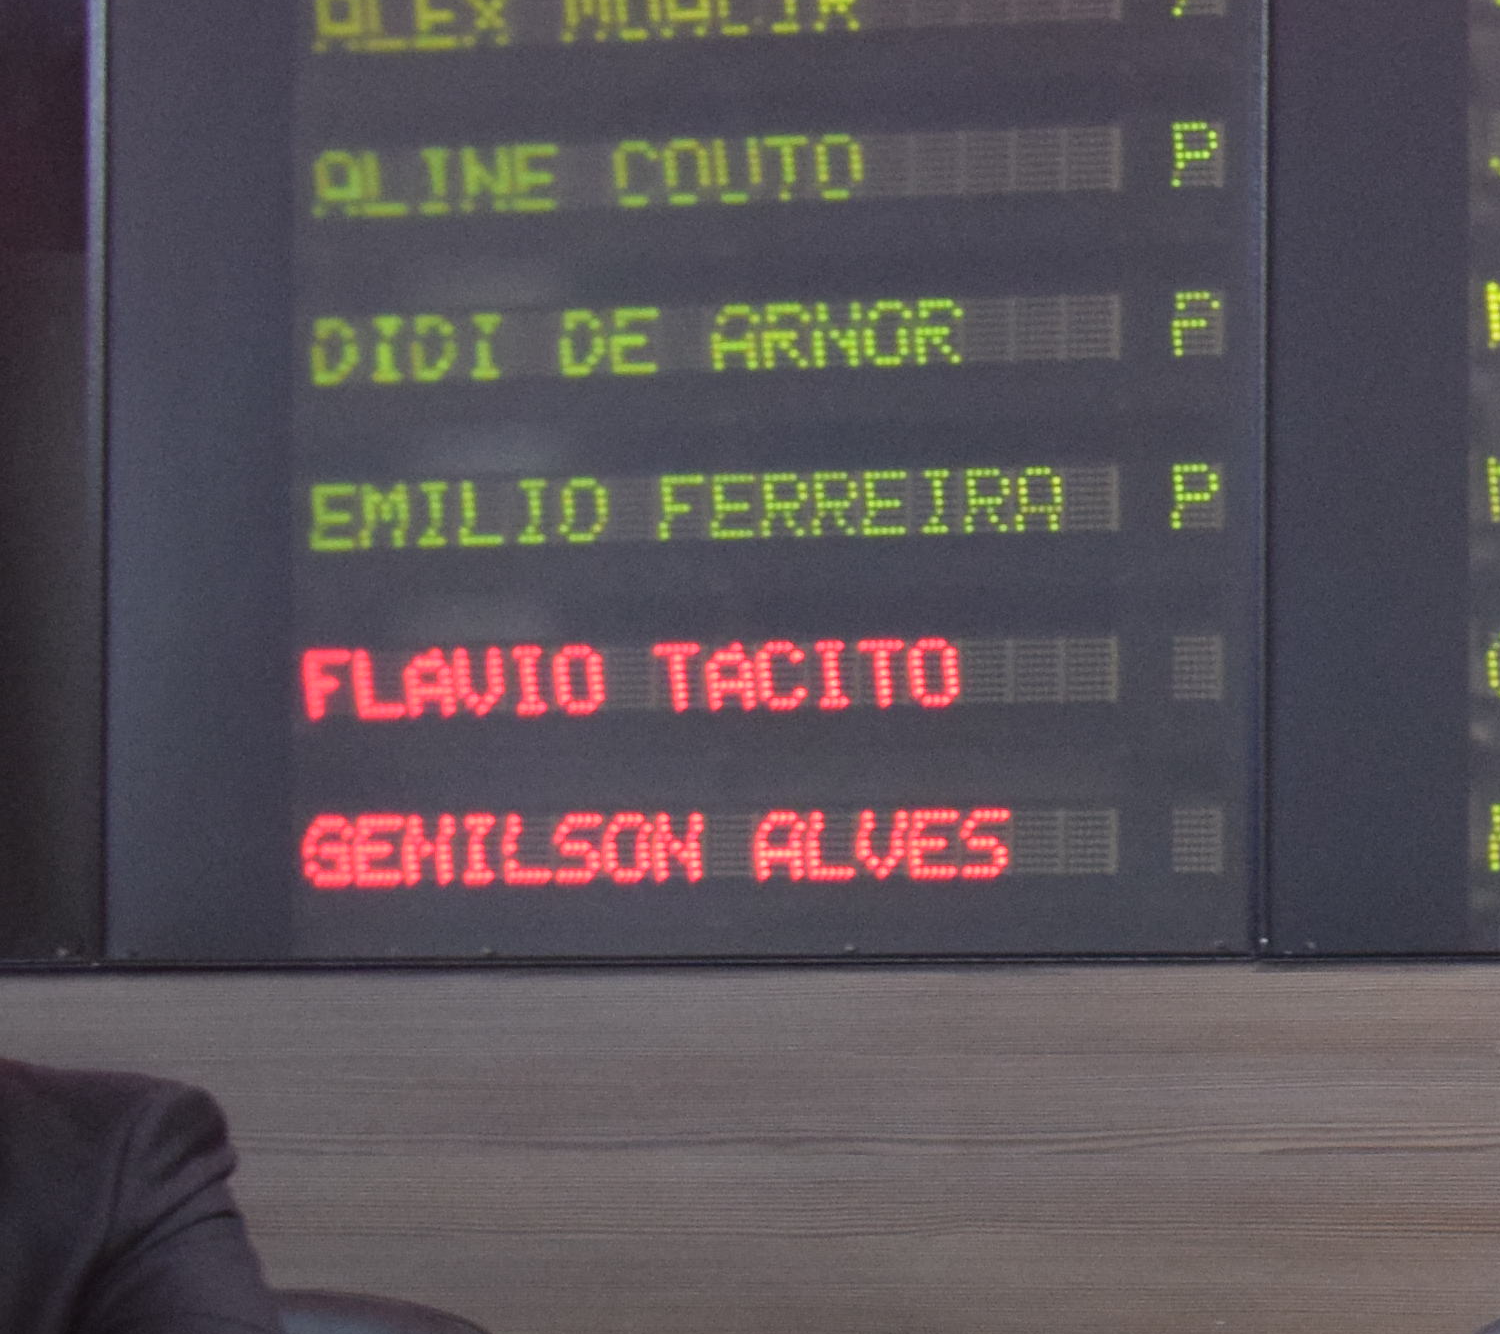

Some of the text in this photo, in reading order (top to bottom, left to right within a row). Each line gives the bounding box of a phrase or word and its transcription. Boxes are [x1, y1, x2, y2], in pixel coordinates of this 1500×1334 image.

[313, 120, 1220, 218] ALINE COUTO P
[310, 312, 503, 388] DIDI
[558, 306, 661, 378] DE
[709, 298, 965, 372] ARNOR
[309, 462, 1222, 552] EMILIO FERREIRA P
[300, 637, 961, 722] FLAVIO TACITO
[300, 807, 1012, 889] GENILSON ALVES
